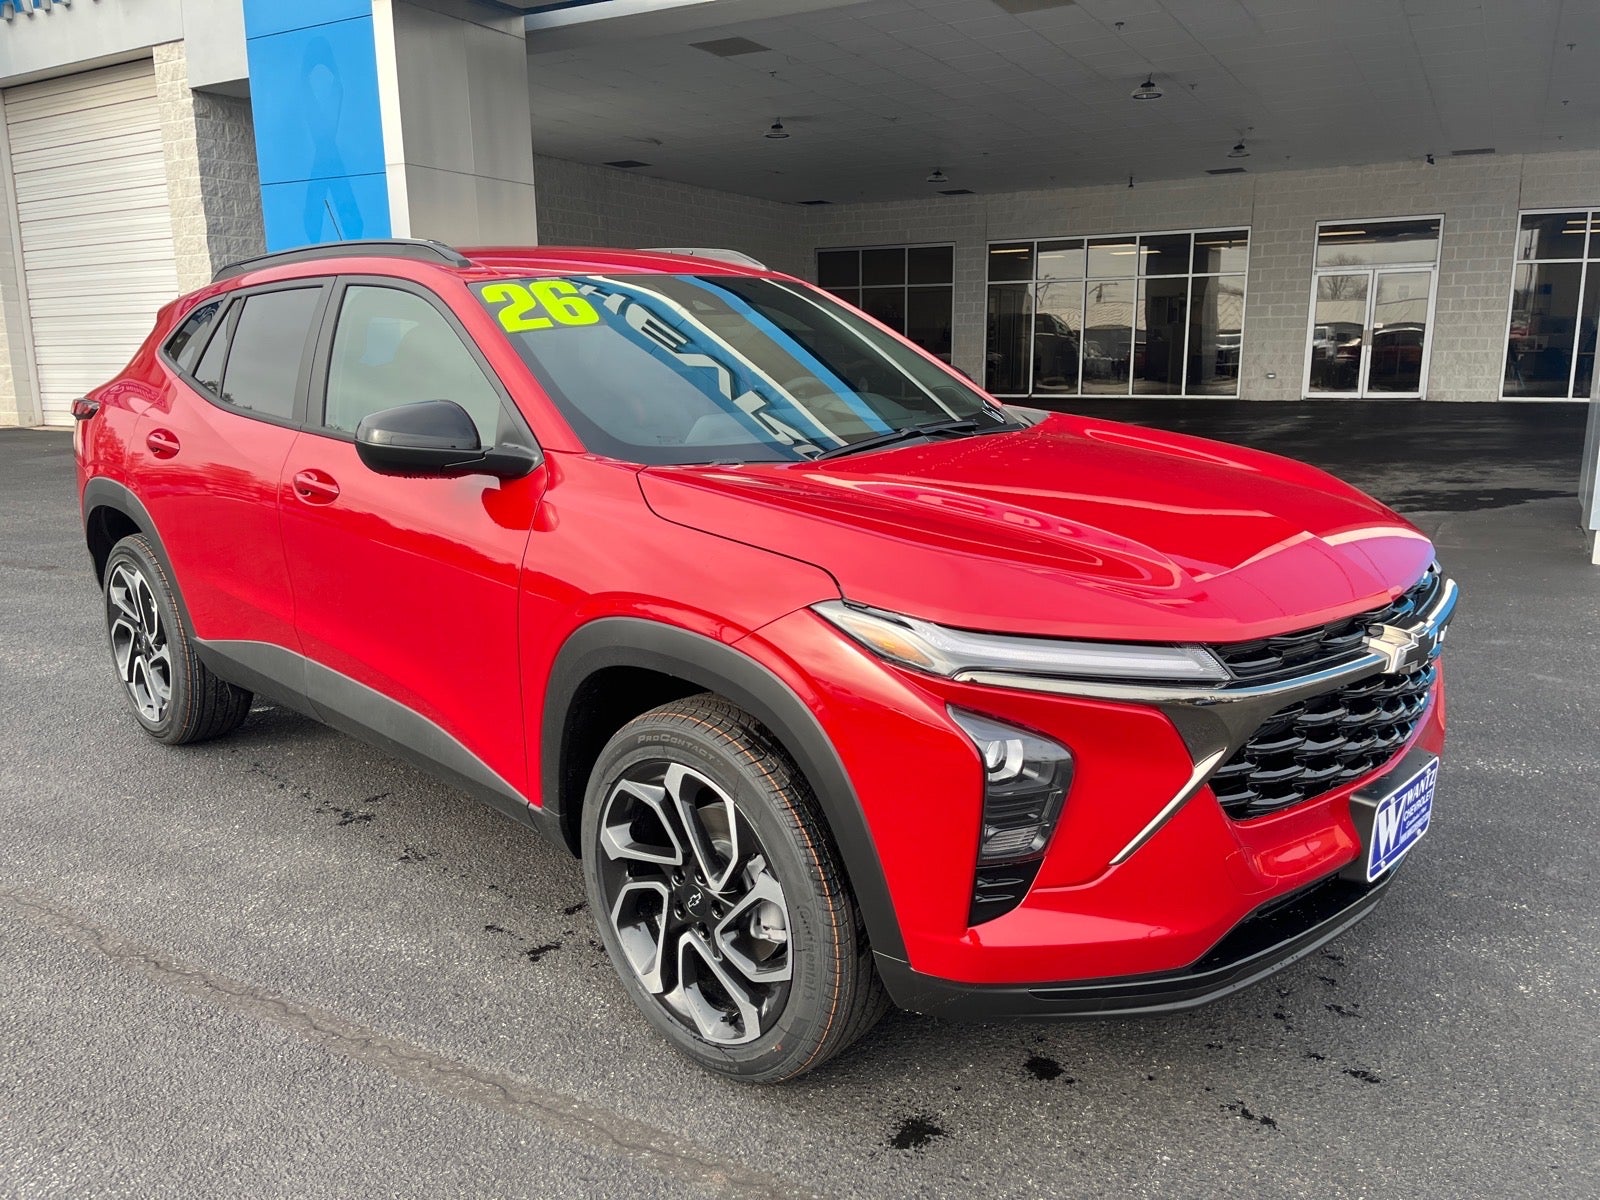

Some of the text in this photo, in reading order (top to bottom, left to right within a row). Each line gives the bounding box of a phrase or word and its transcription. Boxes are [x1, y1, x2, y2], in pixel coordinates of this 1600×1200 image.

[481, 281, 600, 333] 26
[1403, 788, 1433, 822] CHEVROLET
[1406, 769, 1438, 806] WANTZ
[1378, 792, 1407, 859] W
